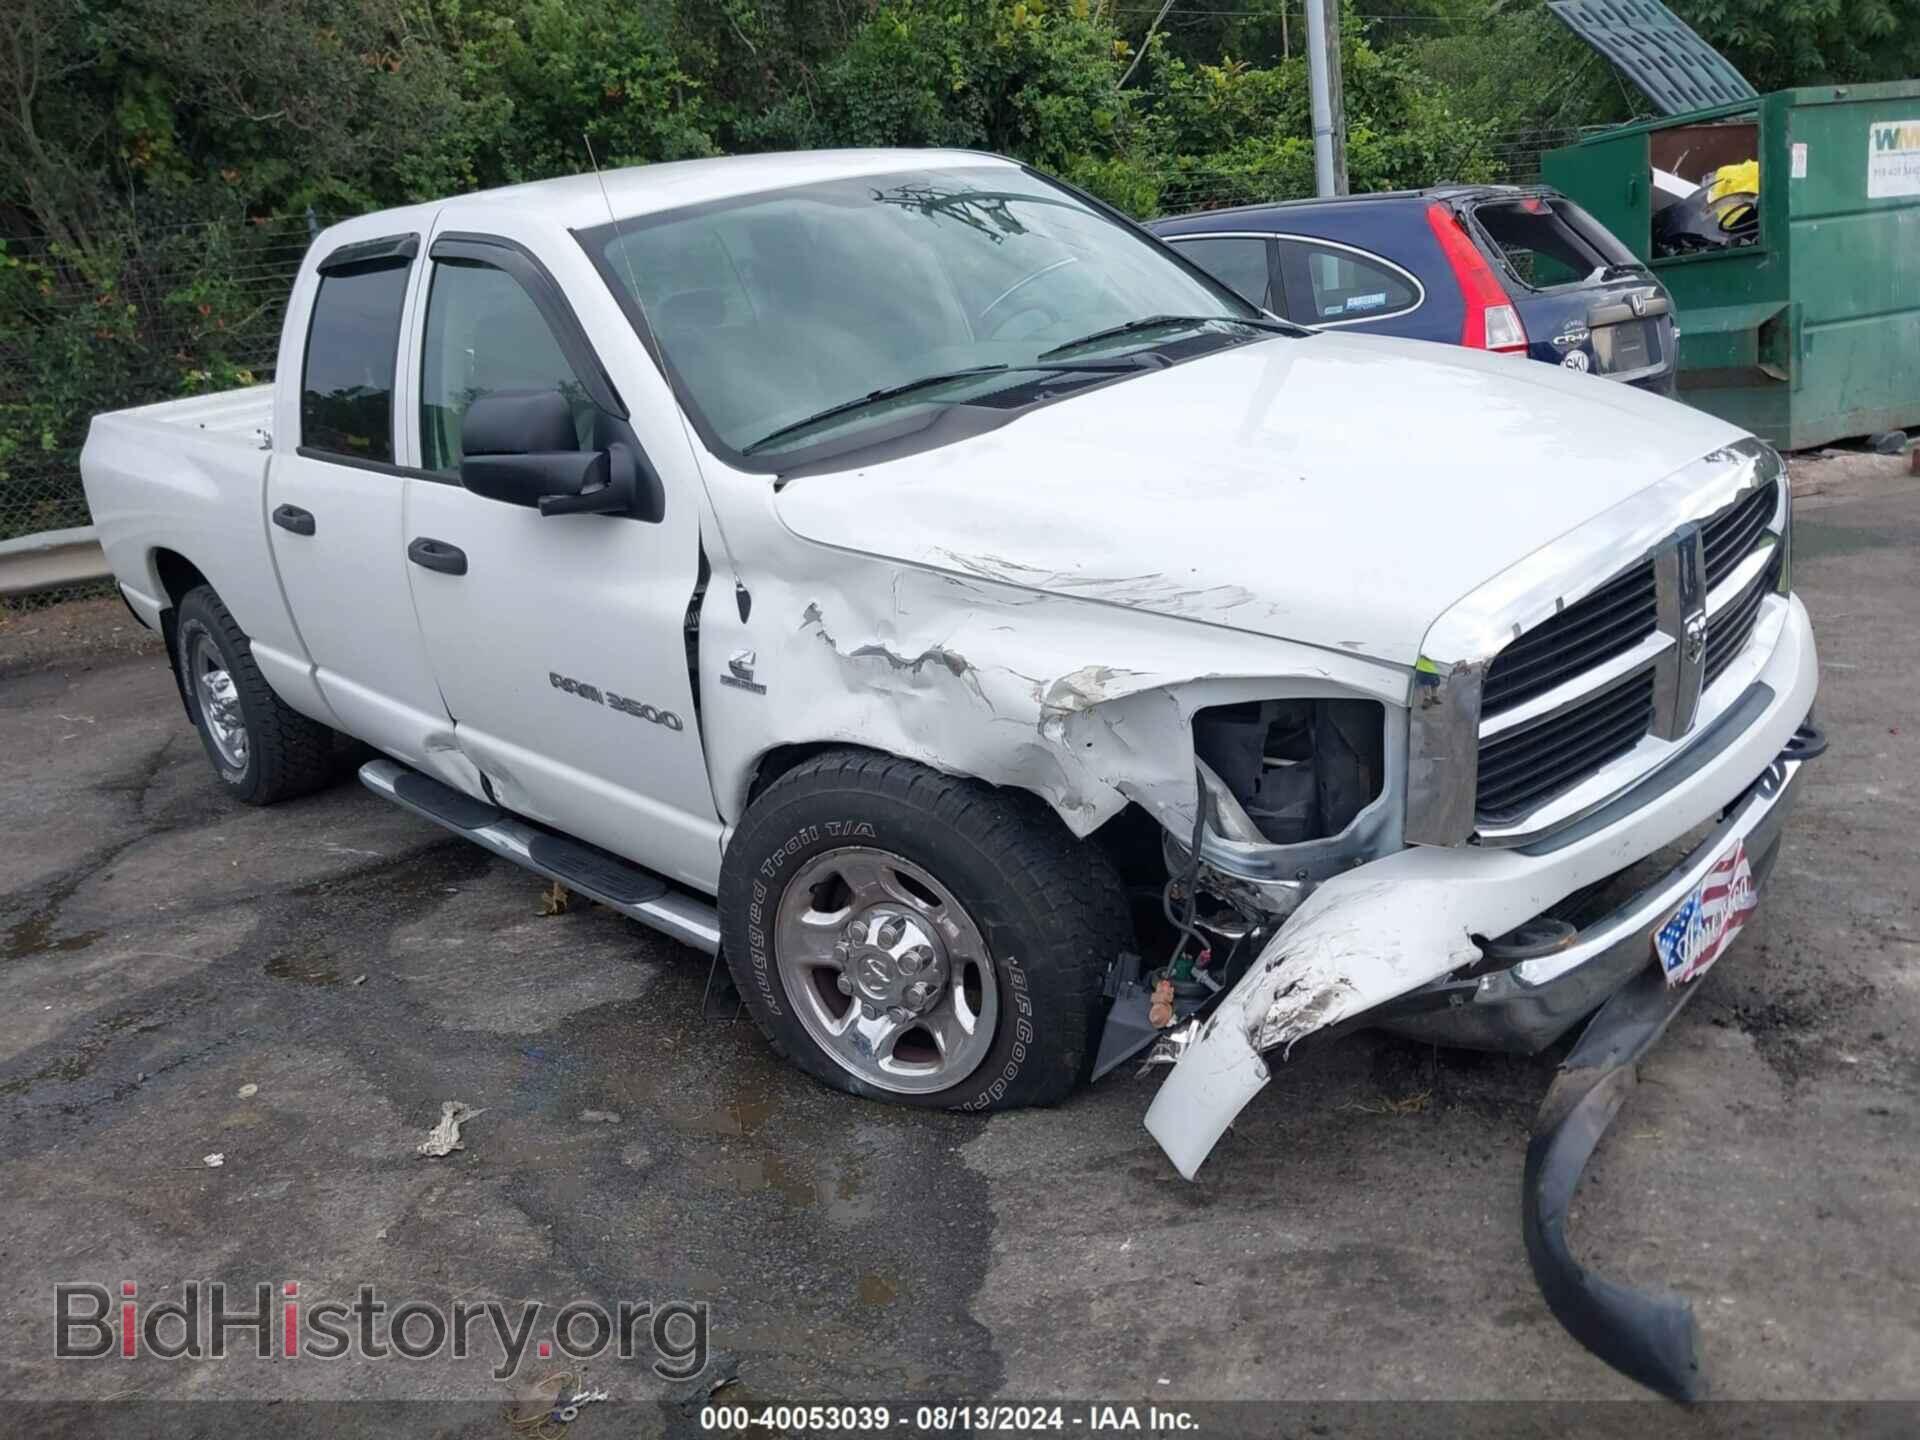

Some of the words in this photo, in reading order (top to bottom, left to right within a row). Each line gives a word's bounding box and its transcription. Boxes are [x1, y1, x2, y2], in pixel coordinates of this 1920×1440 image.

[760, 825, 820, 878] Trail
[824, 821, 877, 838] T/A
[949, 964, 1034, 1111] BFGoodri
